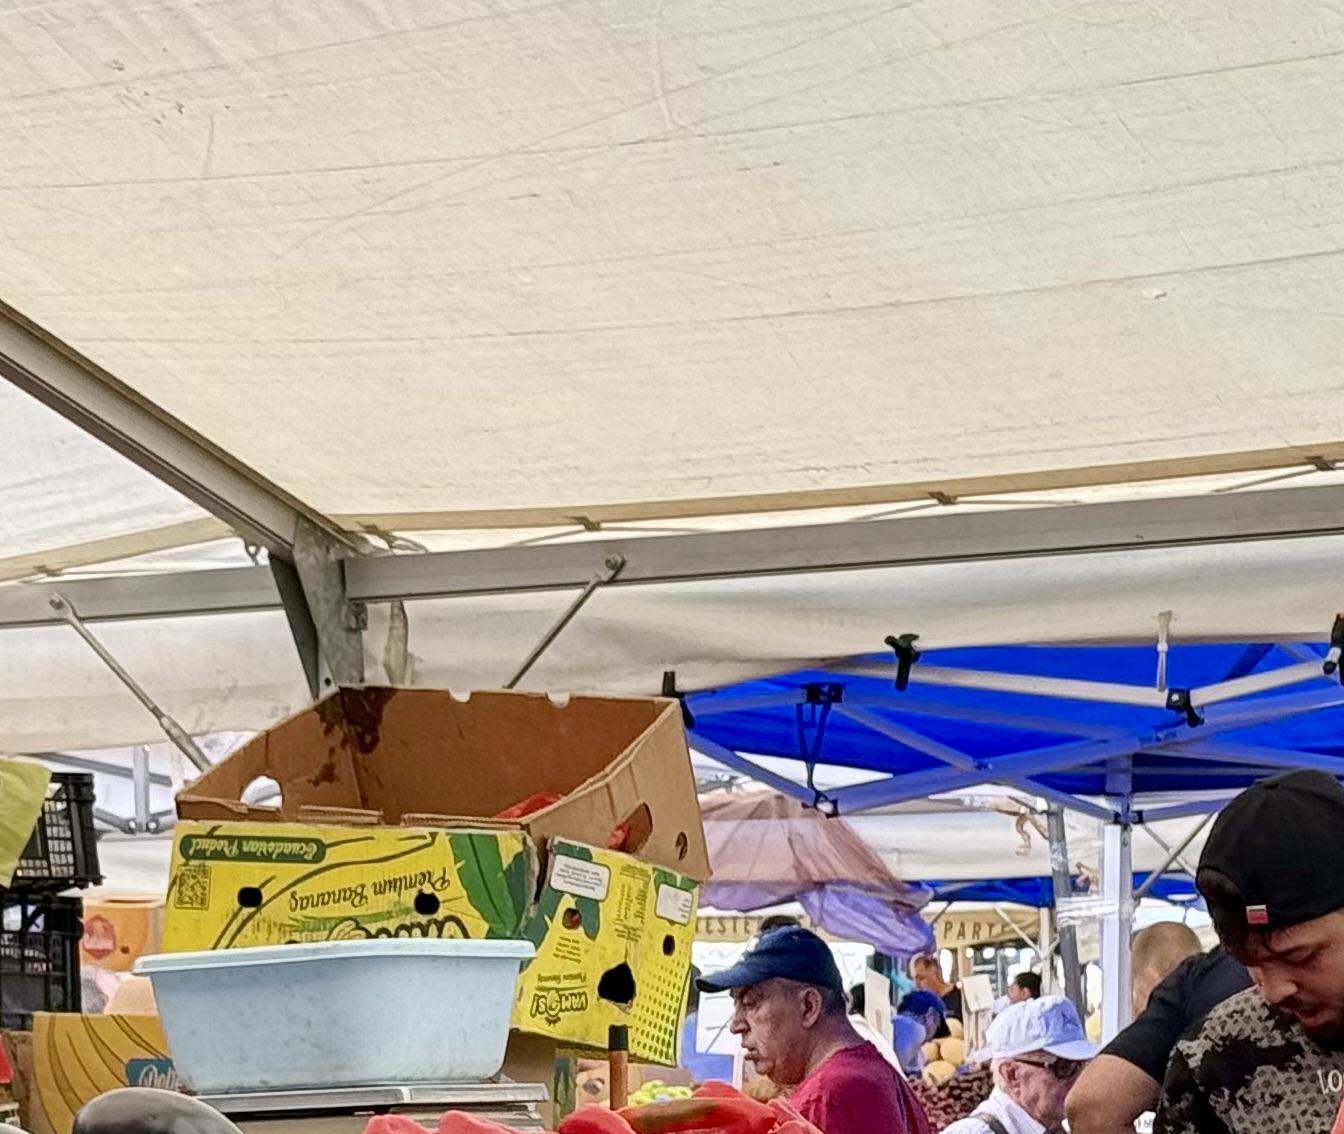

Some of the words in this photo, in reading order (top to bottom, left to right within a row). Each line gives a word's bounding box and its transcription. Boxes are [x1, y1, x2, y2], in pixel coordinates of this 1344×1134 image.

[189, 838, 237, 858] Product
[242, 839, 319, 861] Ecuadorian
[372, 867, 450, 896] Premium
[289, 885, 368, 914] Bananas
[530, 991, 589, 1019] VAMOS!
